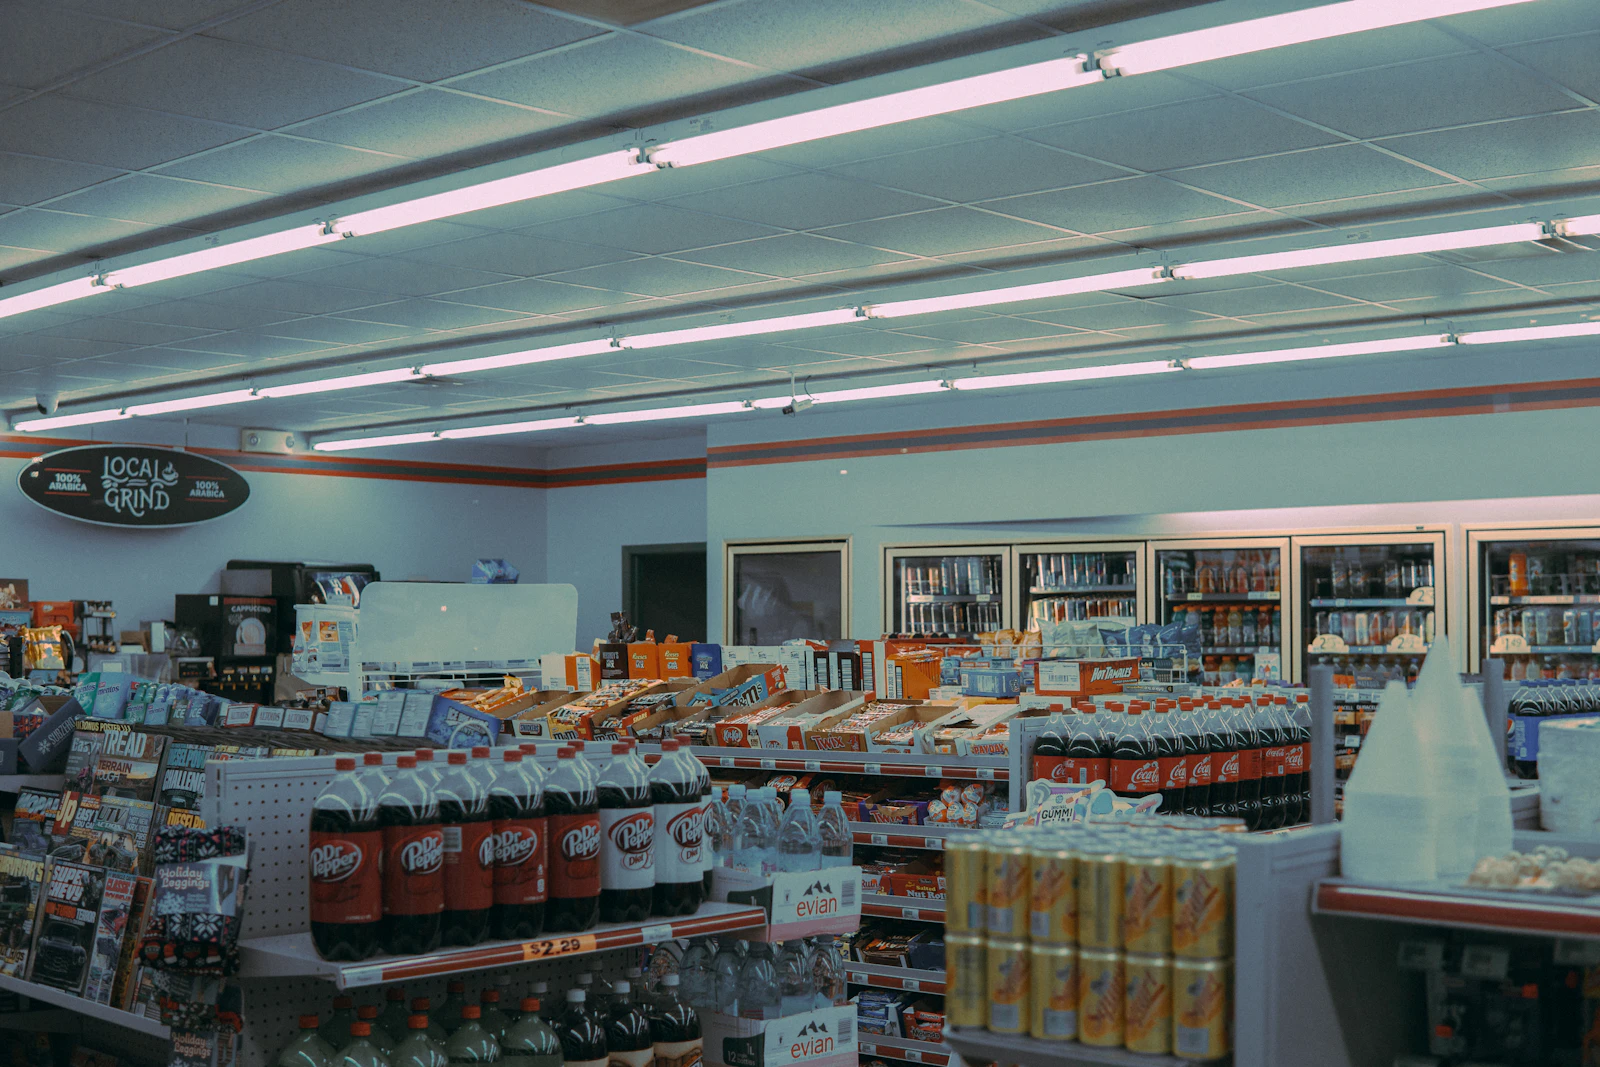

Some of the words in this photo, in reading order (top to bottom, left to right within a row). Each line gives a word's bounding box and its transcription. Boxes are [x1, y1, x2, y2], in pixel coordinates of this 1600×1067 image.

[55, 472, 82, 483] 100%
[101, 456, 178, 486] LOCAL
[48, 482, 88, 492] ARABICA
[195, 480, 219, 490] 100%
[104, 482, 170, 517] GRIND
[188, 489, 225, 498] ARABICA
[231, 605, 272, 613] CAPPUCCINO
[1091, 668, 1107, 682] HOT
[97, 684, 120, 697] mentos
[173, 708, 186, 719] ICE
[189, 707, 202, 718] ICE
[102, 730, 148, 759] TREAD
[98, 763, 133, 774] TERRAIN
[98, 769, 120, 783] TOUGH
[97, 804, 128, 824] UTV
[1041, 808, 1073, 820] GUMMI
[581, 824, 597, 843] Dr
[636, 818, 650, 836] Dr
[422, 836, 439, 853] Dr
[503, 830, 522, 847] Dr
[323, 844, 344, 862] Dr
[629, 855, 645, 867] Diet
[310, 847, 357, 878] Pepper
[53, 865, 90, 886] SUPER
[158, 865, 204, 881] Holiday
[48, 880, 85, 903] CHEVY
[161, 876, 211, 892] Leggings
[915, 884, 936, 893] Salted
[906, 889, 926, 899] Nut
[796, 896, 838, 917] evian
[529, 937, 582, 958] $2.29
[171, 1032, 207, 1049] Holiday
[791, 1036, 835, 1059] evian
[173, 1042, 212, 1059] Leggings
[727, 1050, 737, 1063] 12
